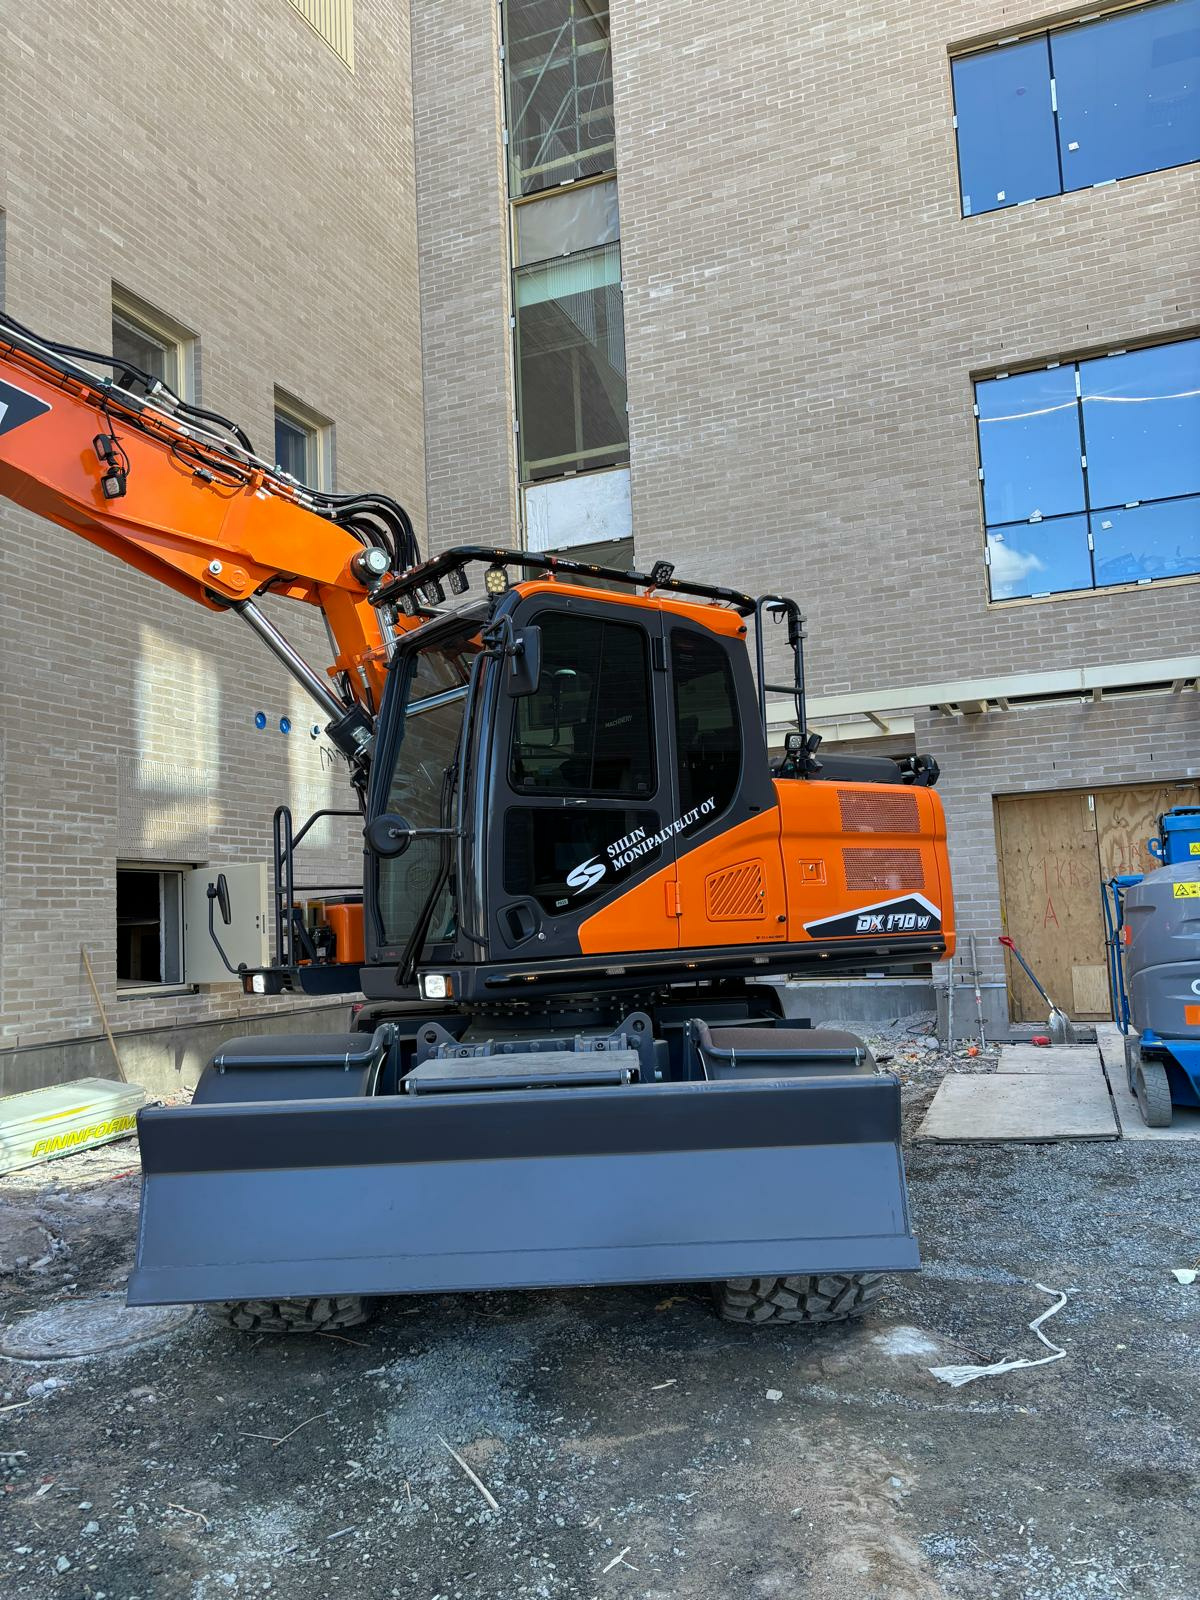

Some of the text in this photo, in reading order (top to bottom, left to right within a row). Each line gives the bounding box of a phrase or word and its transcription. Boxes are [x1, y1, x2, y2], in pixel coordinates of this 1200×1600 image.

[606, 826, 646, 858] SIILIN
[611, 796, 717, 872] MONIPALVELUT OY
[856, 914, 885, 933] DX
[1044, 896, 1060, 929] A
[31, 1113, 138, 1158] FINNFORM
